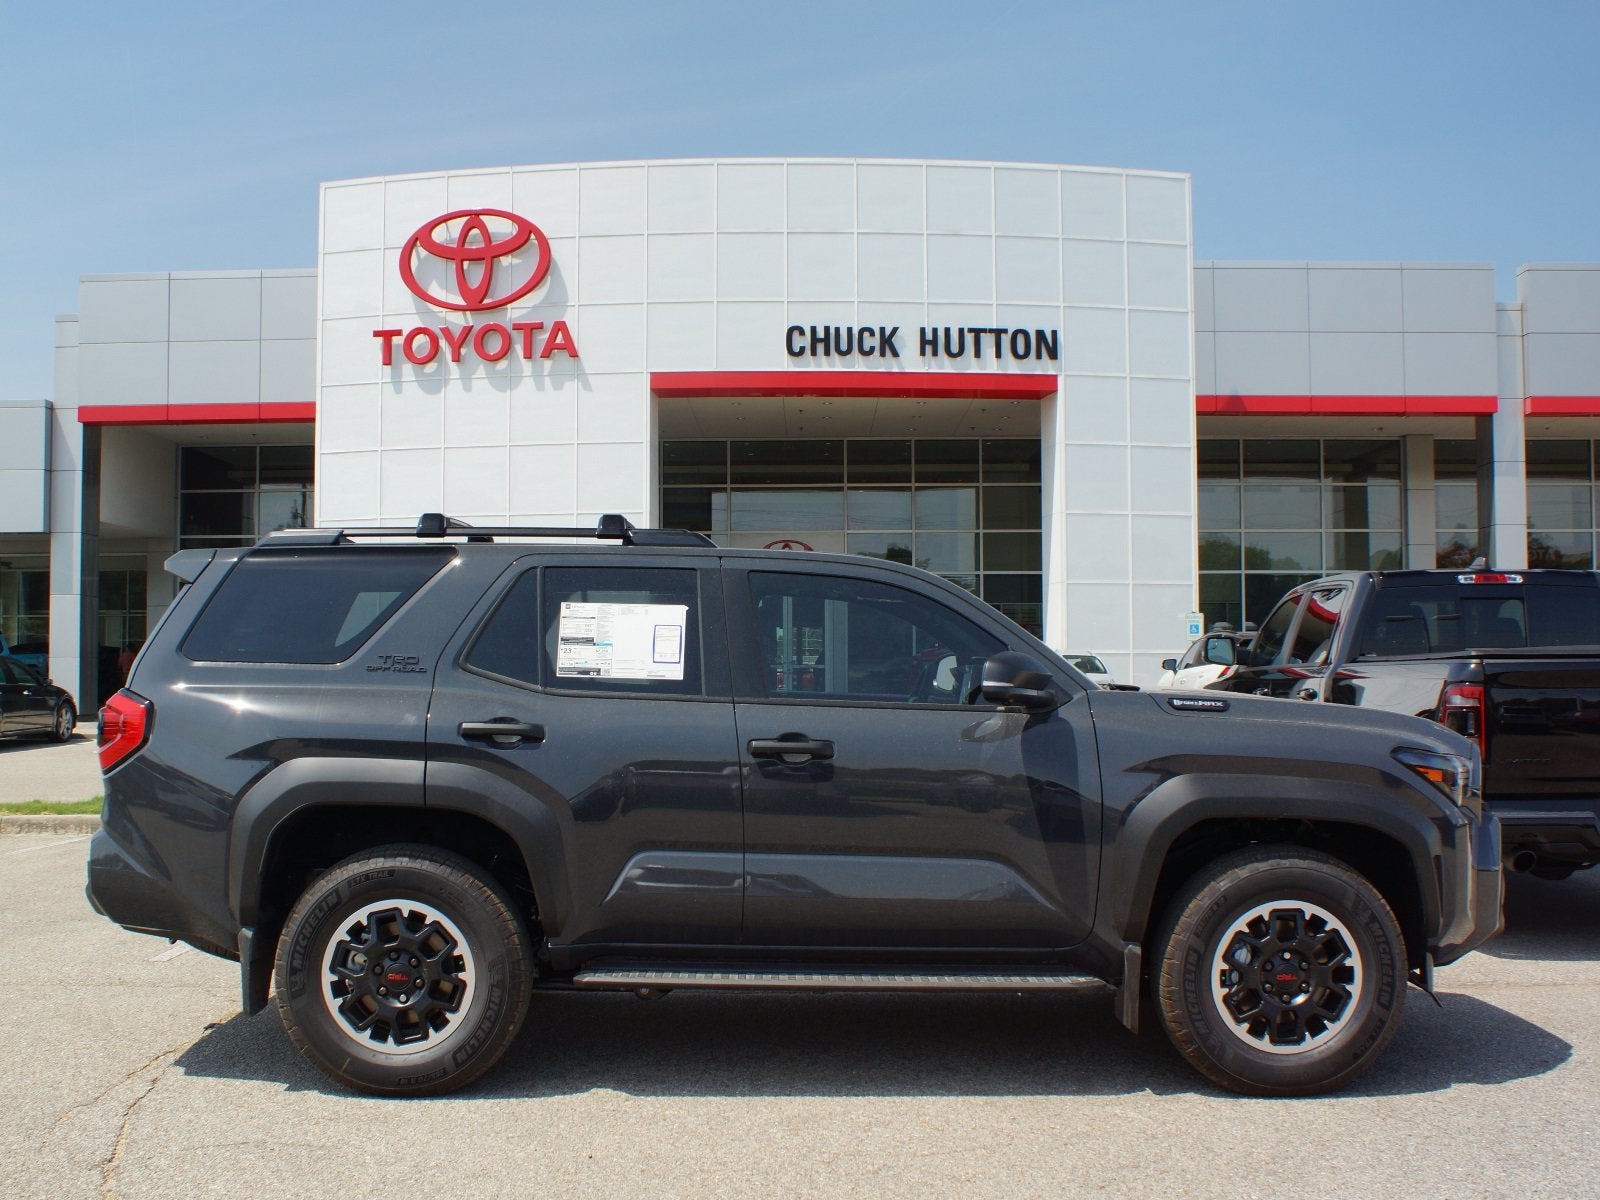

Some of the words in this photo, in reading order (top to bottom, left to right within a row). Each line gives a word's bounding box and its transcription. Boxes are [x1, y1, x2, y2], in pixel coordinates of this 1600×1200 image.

[372, 320, 579, 366] TOYOTA
[786, 325, 900, 358] CHUCK
[919, 326, 1058, 361] HUTTON
[293, 891, 339, 968] MICHELIN
[1369, 920, 1392, 1005] MICHELIN
[454, 987, 504, 1062] MICHELIN
[1184, 950, 1210, 1036] MICHELIN
